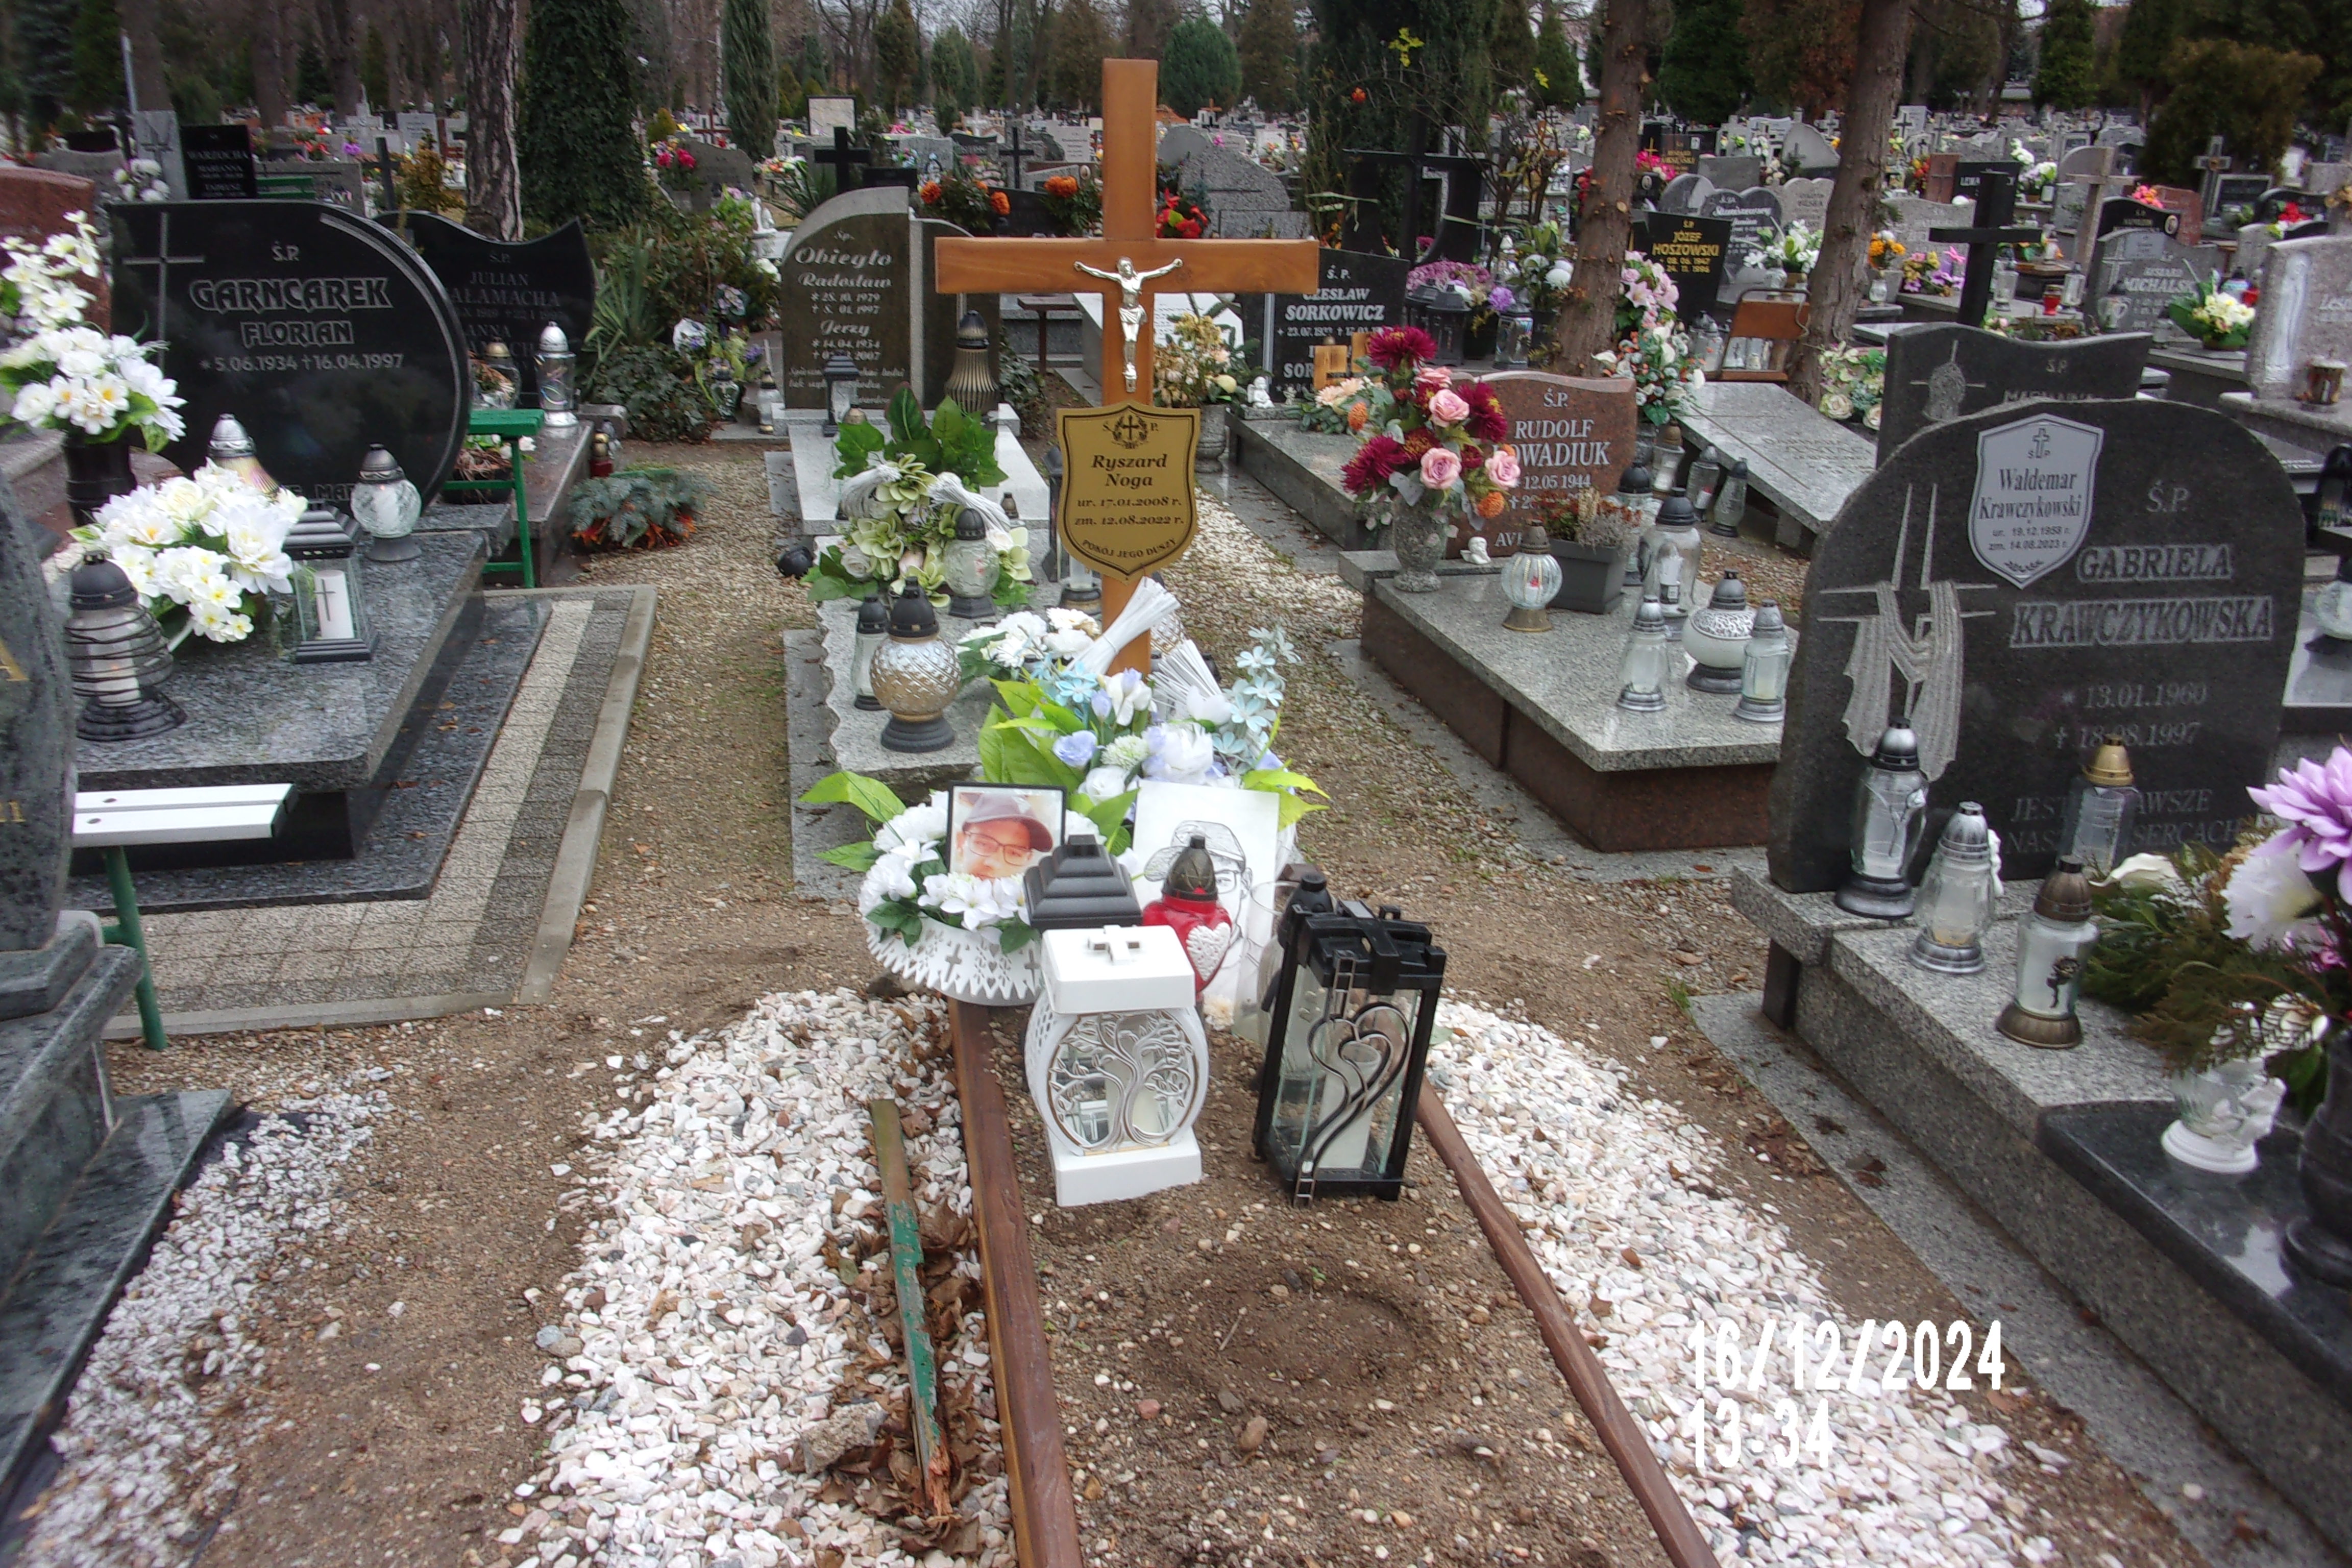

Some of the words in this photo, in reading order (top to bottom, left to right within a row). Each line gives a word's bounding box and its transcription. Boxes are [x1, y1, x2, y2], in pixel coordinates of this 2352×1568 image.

[1651, 242, 1720, 257] HOSZOWSKI
[469, 271, 529, 286] JULIAN
[189, 277, 394, 314] GARNCAREK
[1284, 305, 1385, 321] SORKOWICZ
[240, 320, 355, 349] FLORIAN
[820, 319, 870, 337] Jerzy
[315, 353, 405, 370] 16.04.1997
[1514, 419, 1595, 439] RUDOLF
[1091, 454, 1168, 472] Ryszard
[1491, 441, 1611, 467] OWADIUK
[1105, 473, 1153, 490] Noga
[1999, 468, 2077, 491] Waldemar
[1978, 494, 2082, 524] Krawczykowski
[1101, 515, 1172, 525] 12.08.2022
[1146, 537, 1177, 556] DUSZY
[2076, 544, 2233, 582] GABRIELA
[2010, 595, 2274, 648] KRAWCZYKOWSKA
[2084, 682, 2208, 708] 13.01.1960
[2079, 722, 2201, 749] 18.8.1997
[2136, 789, 2213, 815] AWSZE
